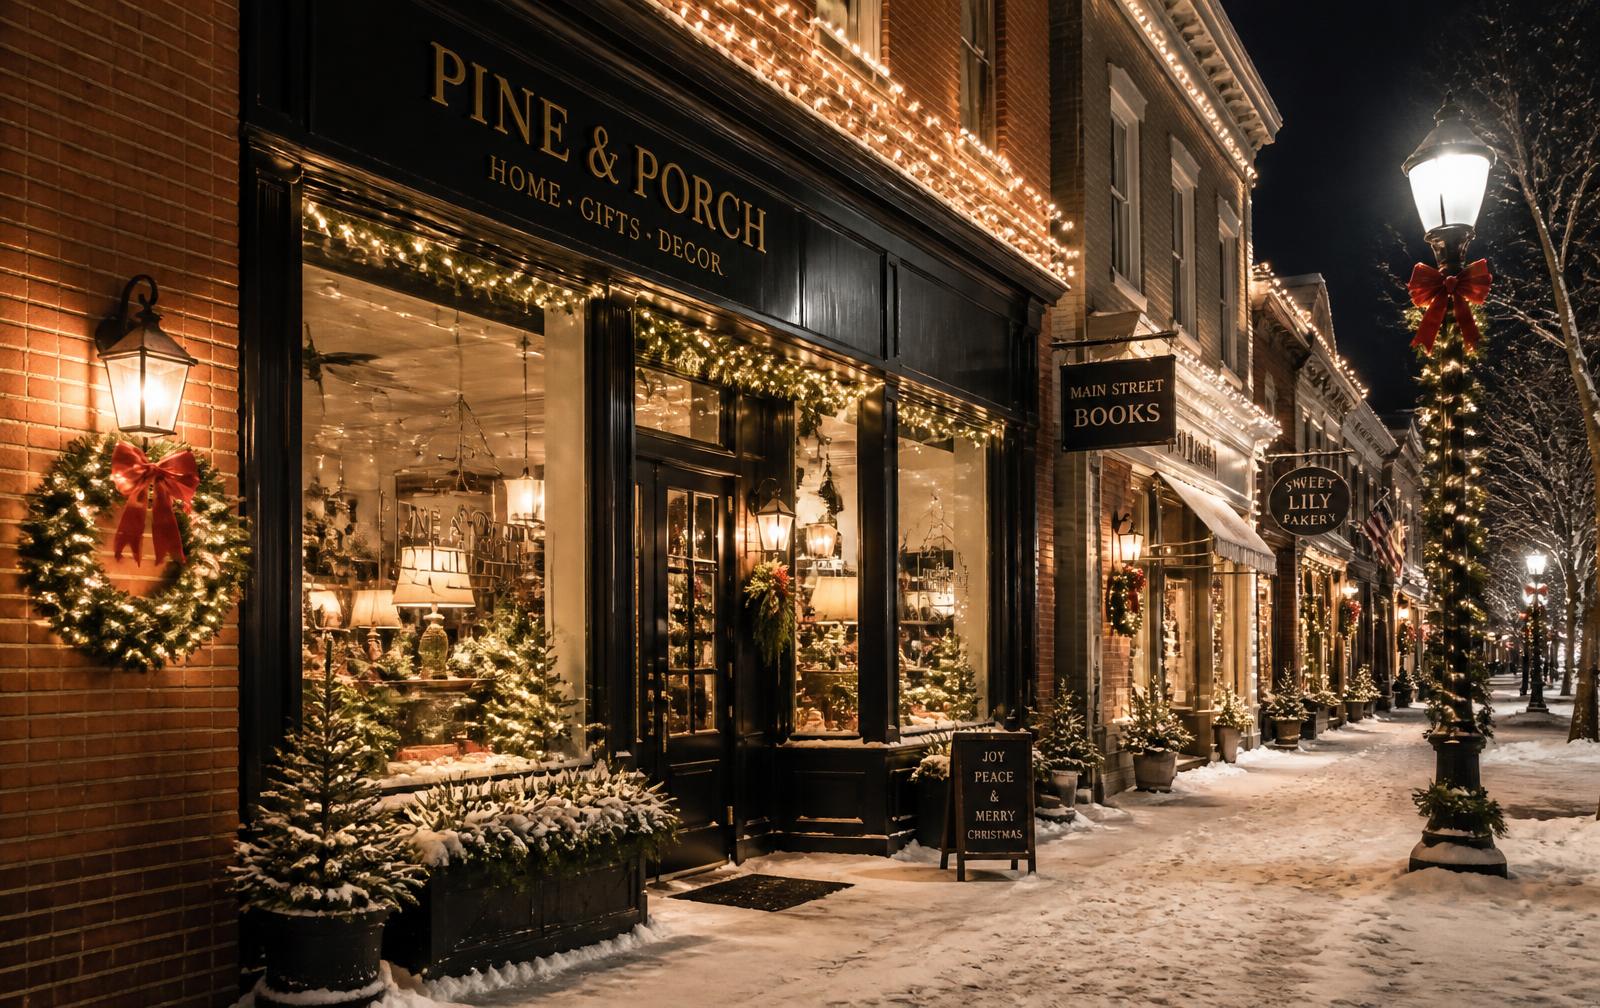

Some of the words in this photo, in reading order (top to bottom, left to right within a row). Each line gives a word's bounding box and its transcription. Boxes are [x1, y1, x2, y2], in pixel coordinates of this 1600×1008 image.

[430, 41, 569, 162] PINE
[587, 125, 619, 185] &
[633, 145, 767, 254] PORCH
[489, 155, 561, 208] HOME
[580, 197, 641, 240] GIFTS
[659, 229, 725, 276] DECOR
[1070, 384, 1106, 399] MAIN
[1111, 379, 1164, 395] STREET
[1074, 403, 1160, 428] BOOKS
[1289, 493, 1332, 510] LILY
[982, 751, 1005, 763] JOY
[975, 771, 1014, 783] PEACE
[990, 790, 999, 802] &
[975, 810, 1016, 822] MERRY
[967, 829, 1023, 840] CHRISTMAS
